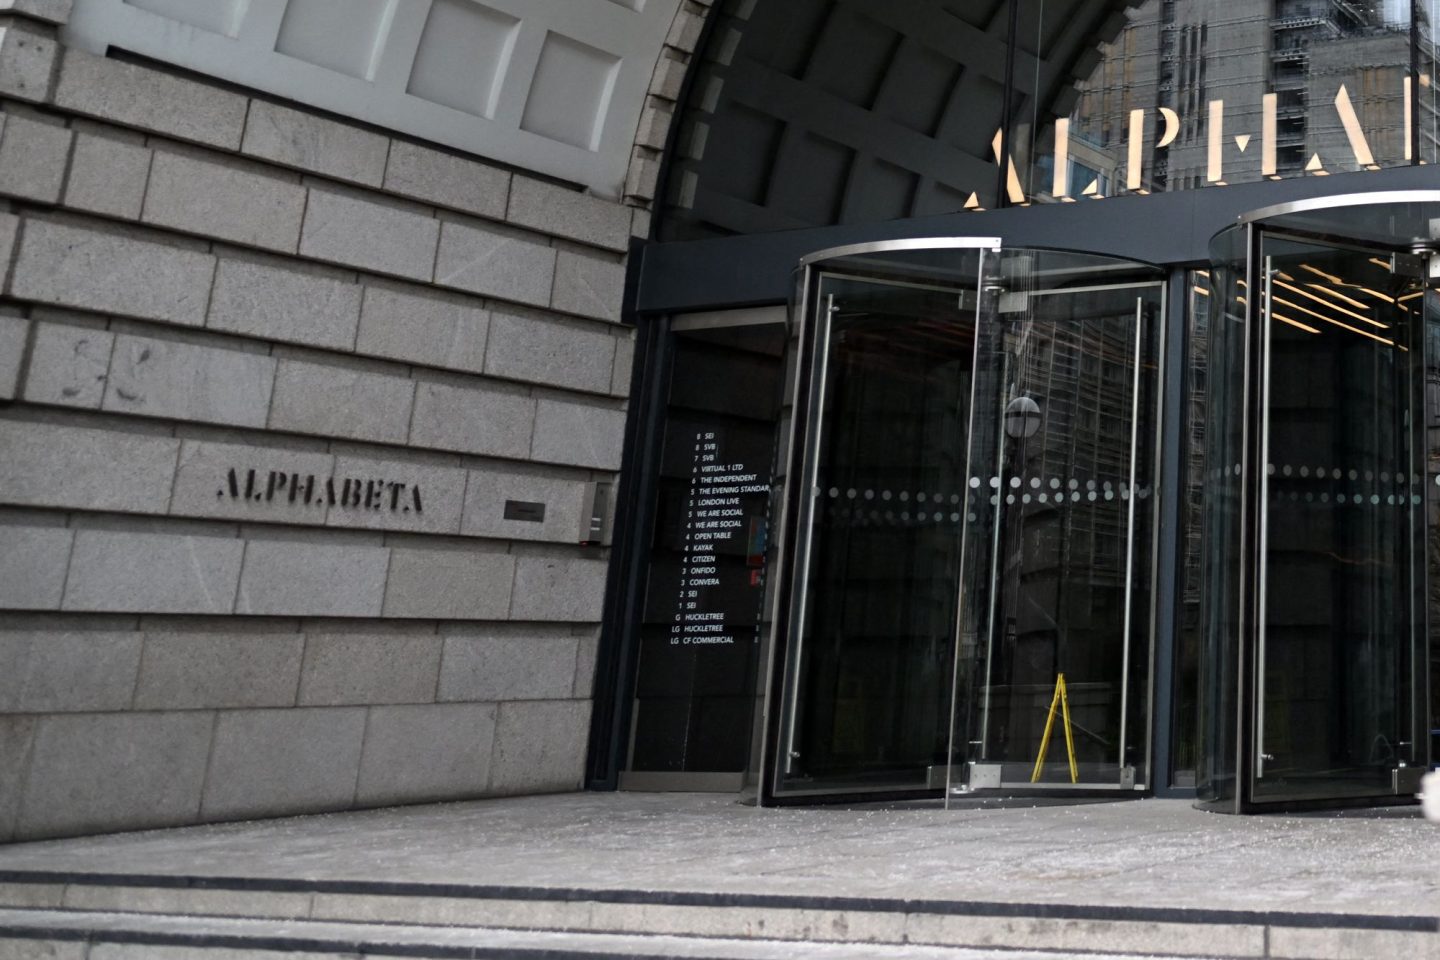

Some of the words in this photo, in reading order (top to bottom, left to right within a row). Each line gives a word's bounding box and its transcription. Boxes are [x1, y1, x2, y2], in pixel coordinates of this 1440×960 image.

[704, 432, 715, 440] SEI
[704, 443, 716, 451] SVB
[701, 465, 726, 473] VIRTUAL
[732, 463, 744, 471] LTD
[700, 476, 712, 484] THE
[713, 473, 757, 483] INDEPENDENT
[216, 467, 423, 513] ALPHABETA
[699, 487, 711, 495] THE
[712, 486, 740, 494] EVENING
[740, 484, 770, 493] STANDAR
[698, 498, 726, 506] LONDON
[726, 497, 740, 505] LIVE
[688, 510, 693, 518] 5
[708, 509, 720, 517] ARE
[721, 508, 743, 516] SOCIAL
[719, 520, 742, 528] SOCIAL
[713, 531, 732, 539] TABLE
[691, 555, 716, 563] CITIZEN
[682, 567, 687, 575] 3
[690, 566, 716, 574] ONFIDO
[689, 578, 720, 586] CONVERA
[688, 590, 698, 598] SEI
[675, 613, 681, 621] G
[685, 612, 725, 621] HUCKLETREE
[671, 625, 680, 633] LG
[684, 624, 723, 632] HUCKLETREE
[670, 637, 680, 645] LG
[692, 636, 735, 644] COMMERCIAL
